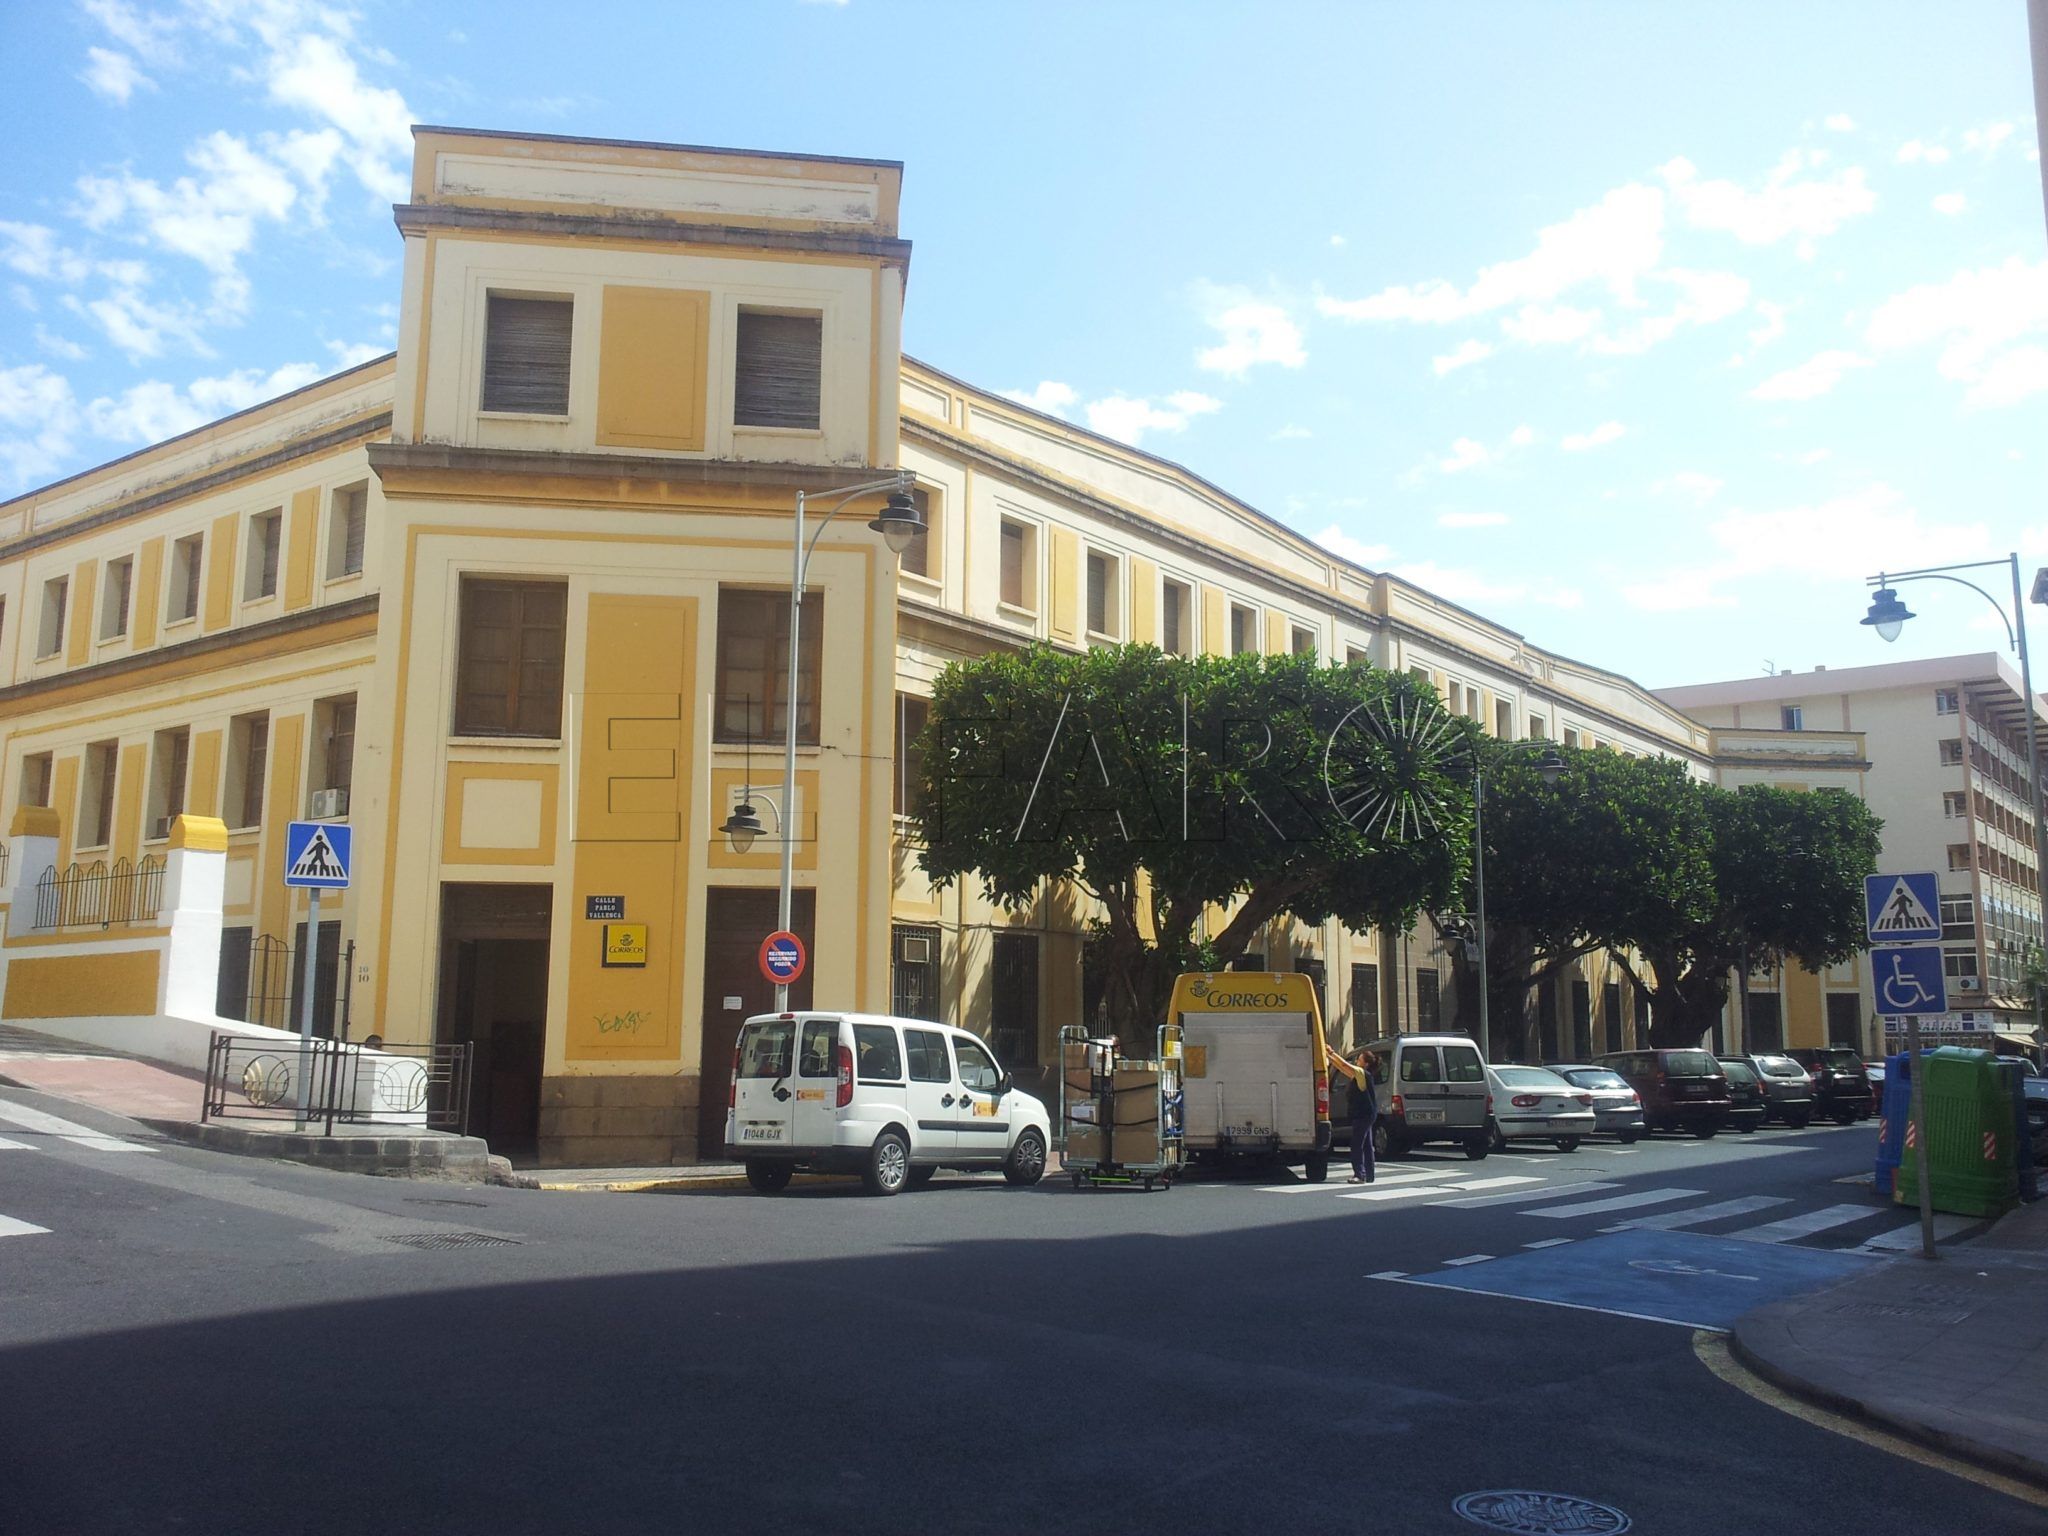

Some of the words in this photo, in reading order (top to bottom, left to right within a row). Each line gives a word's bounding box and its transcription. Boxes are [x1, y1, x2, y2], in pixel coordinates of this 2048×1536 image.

[609, 945, 644, 953] CORREOS
[1207, 990, 1288, 1008] CORREOS
[747, 1128, 764, 1138] 1048
[766, 1128, 782, 1139] GJX
